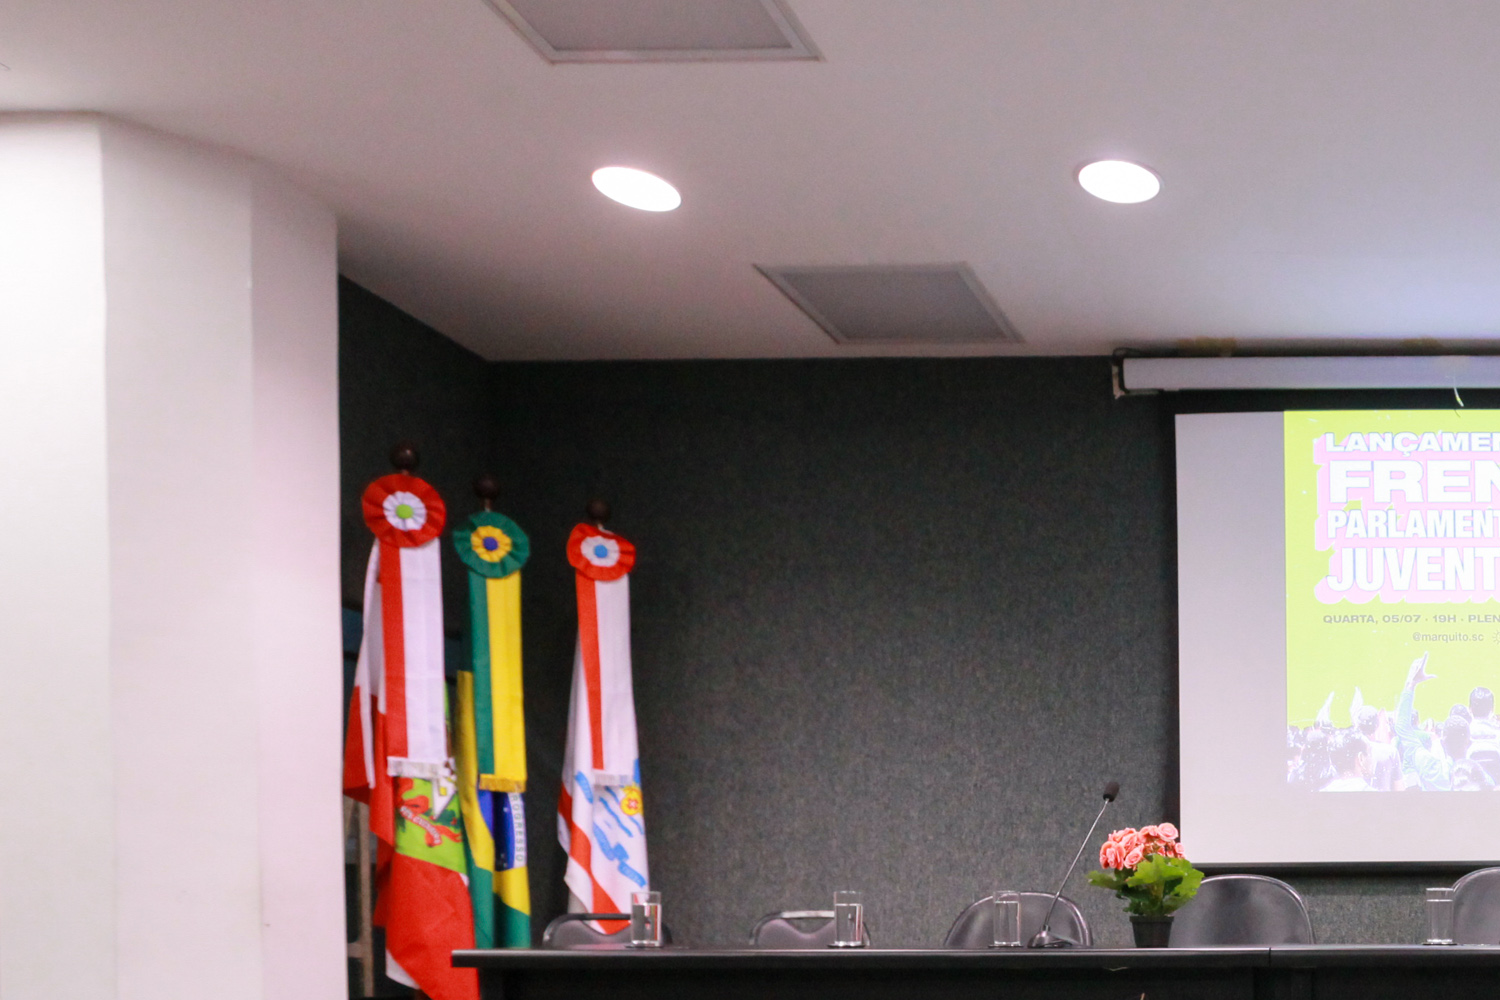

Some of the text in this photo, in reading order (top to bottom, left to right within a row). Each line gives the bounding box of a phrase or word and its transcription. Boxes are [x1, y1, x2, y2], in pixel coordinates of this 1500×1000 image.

[1322, 614, 1379, 625] QUARTA,
[1382, 614, 1422, 624] 05/07
[1432, 614, 1457, 624] 19H
[1412, 631, 1485, 643] @marquito.sc
[511, 793, 525, 862] ROGRESSO
